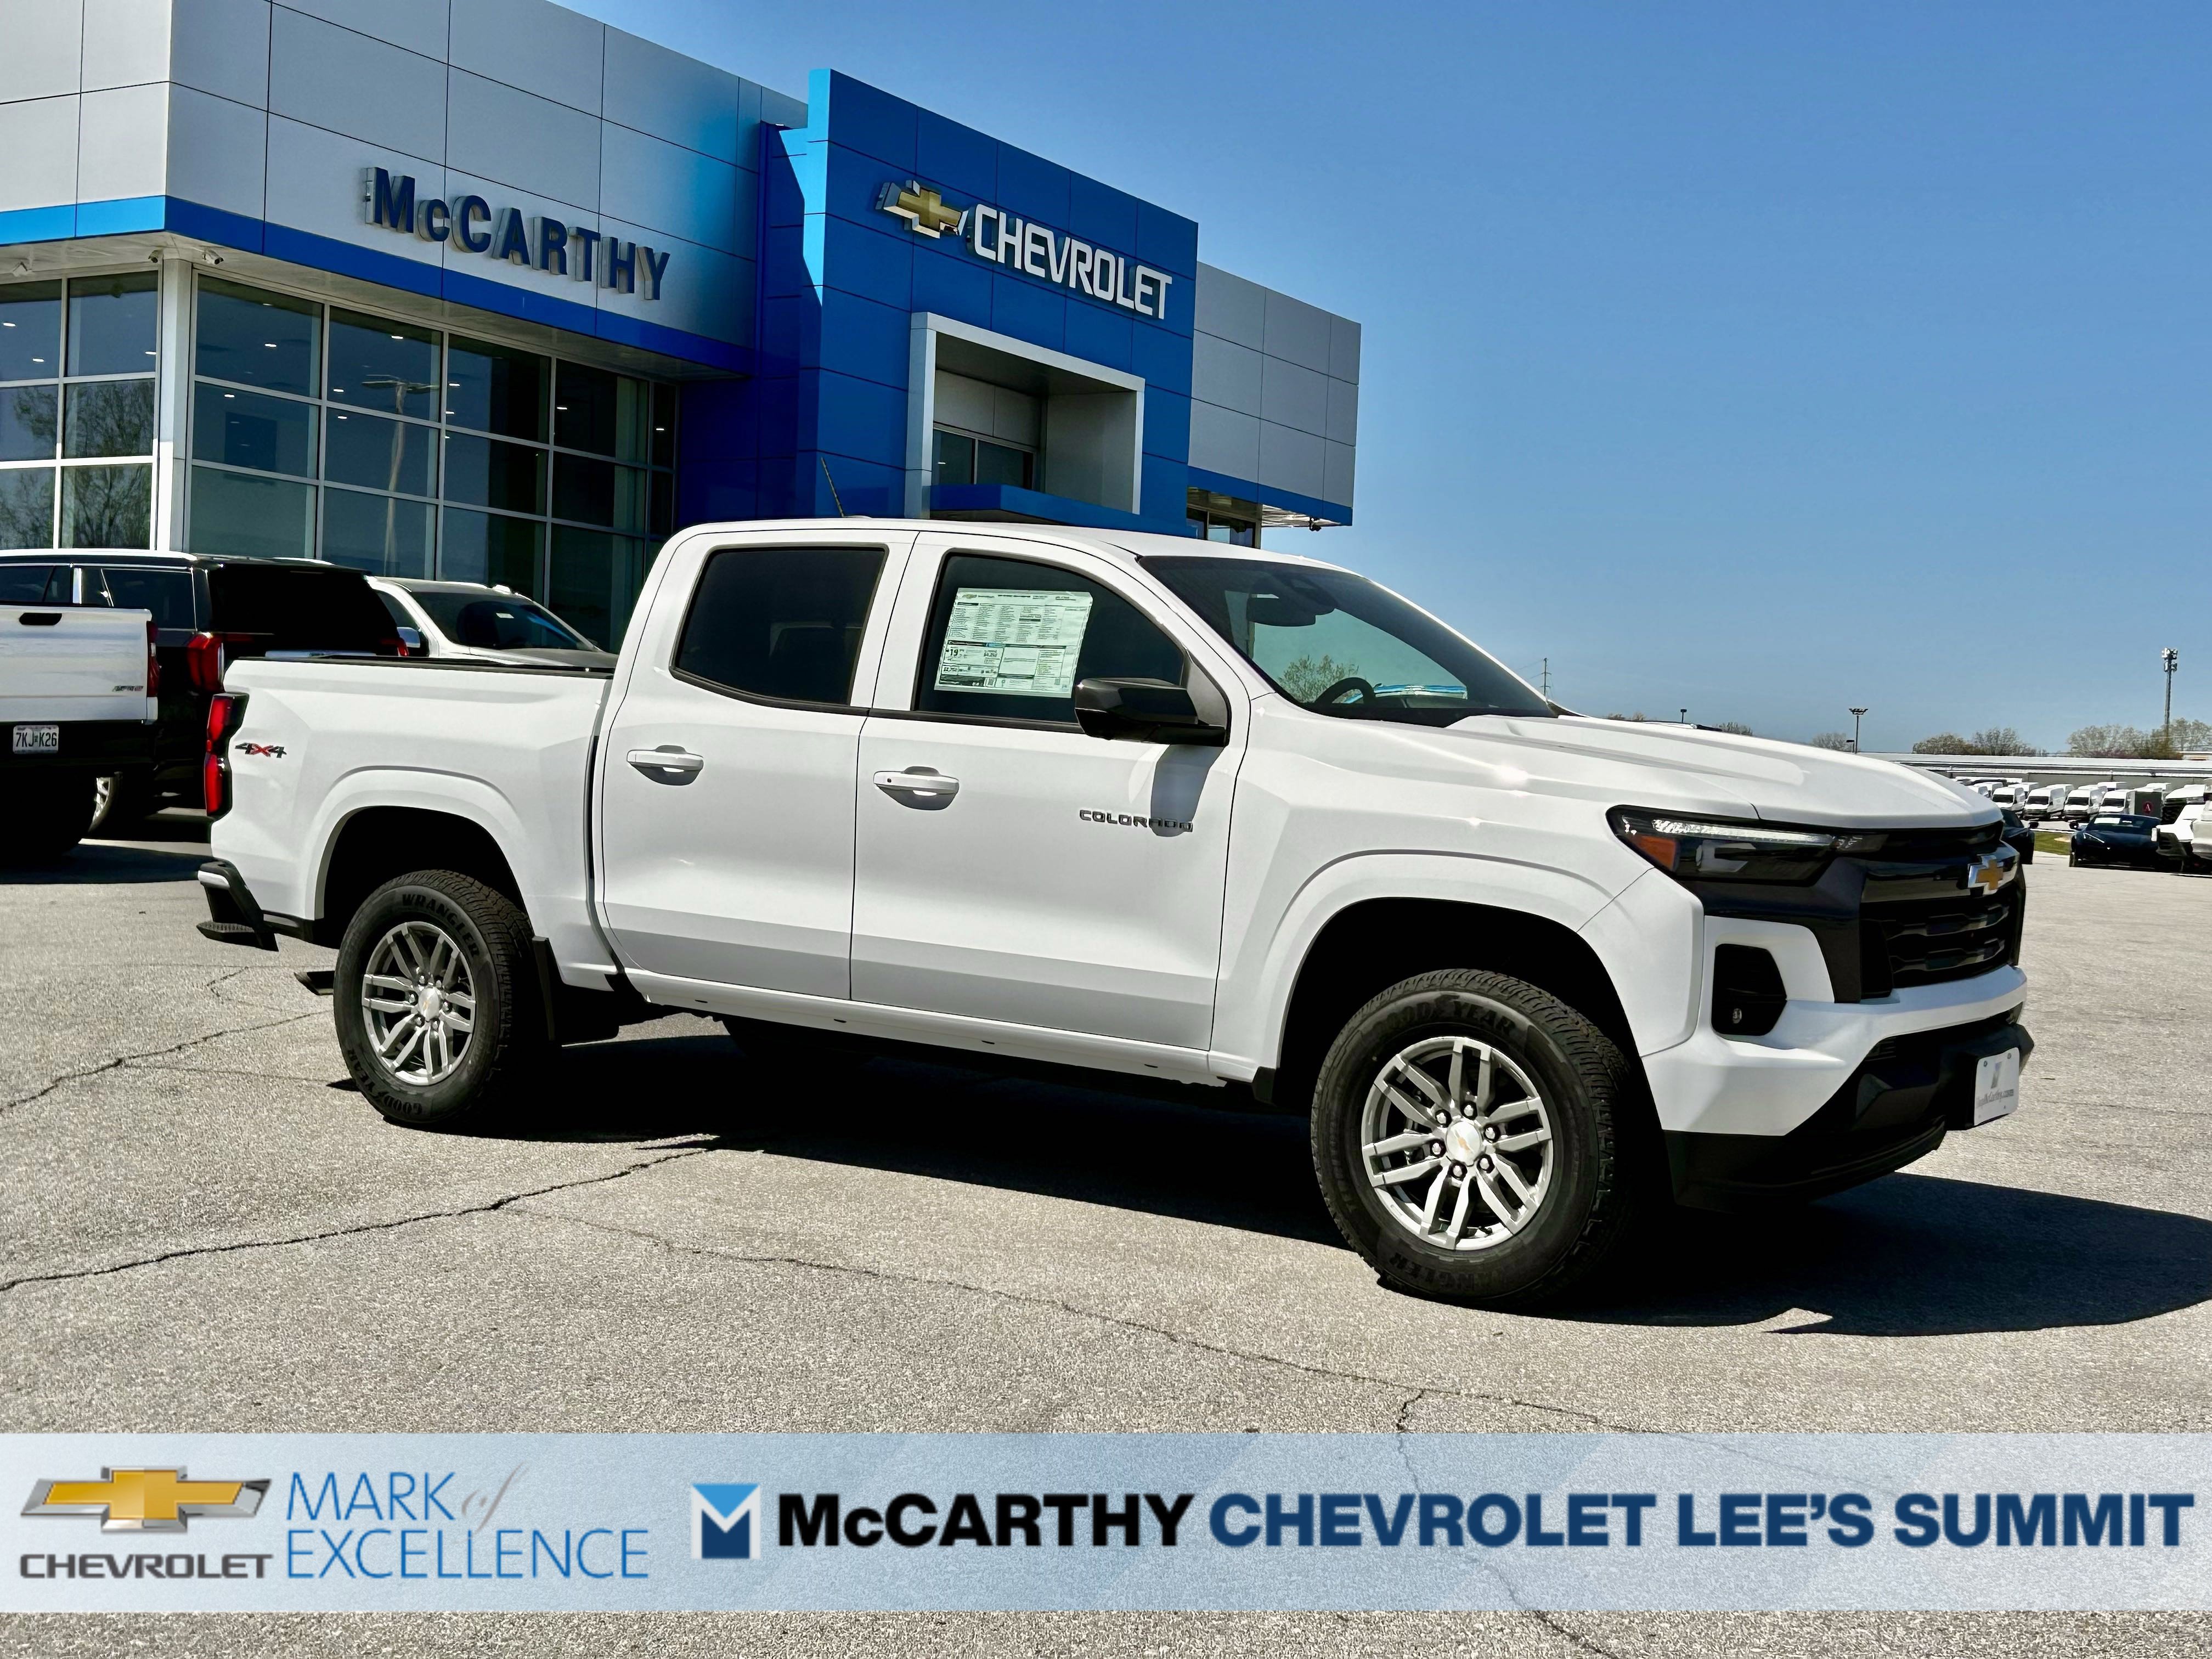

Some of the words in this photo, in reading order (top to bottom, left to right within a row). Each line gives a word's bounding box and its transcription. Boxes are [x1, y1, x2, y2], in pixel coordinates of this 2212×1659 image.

[365, 167, 670, 301] McCARTHY
[973, 203, 1172, 320] CHEVROLET
[1079, 809, 1194, 833] COLORADO
[402, 894, 479, 957] WRANGLER
